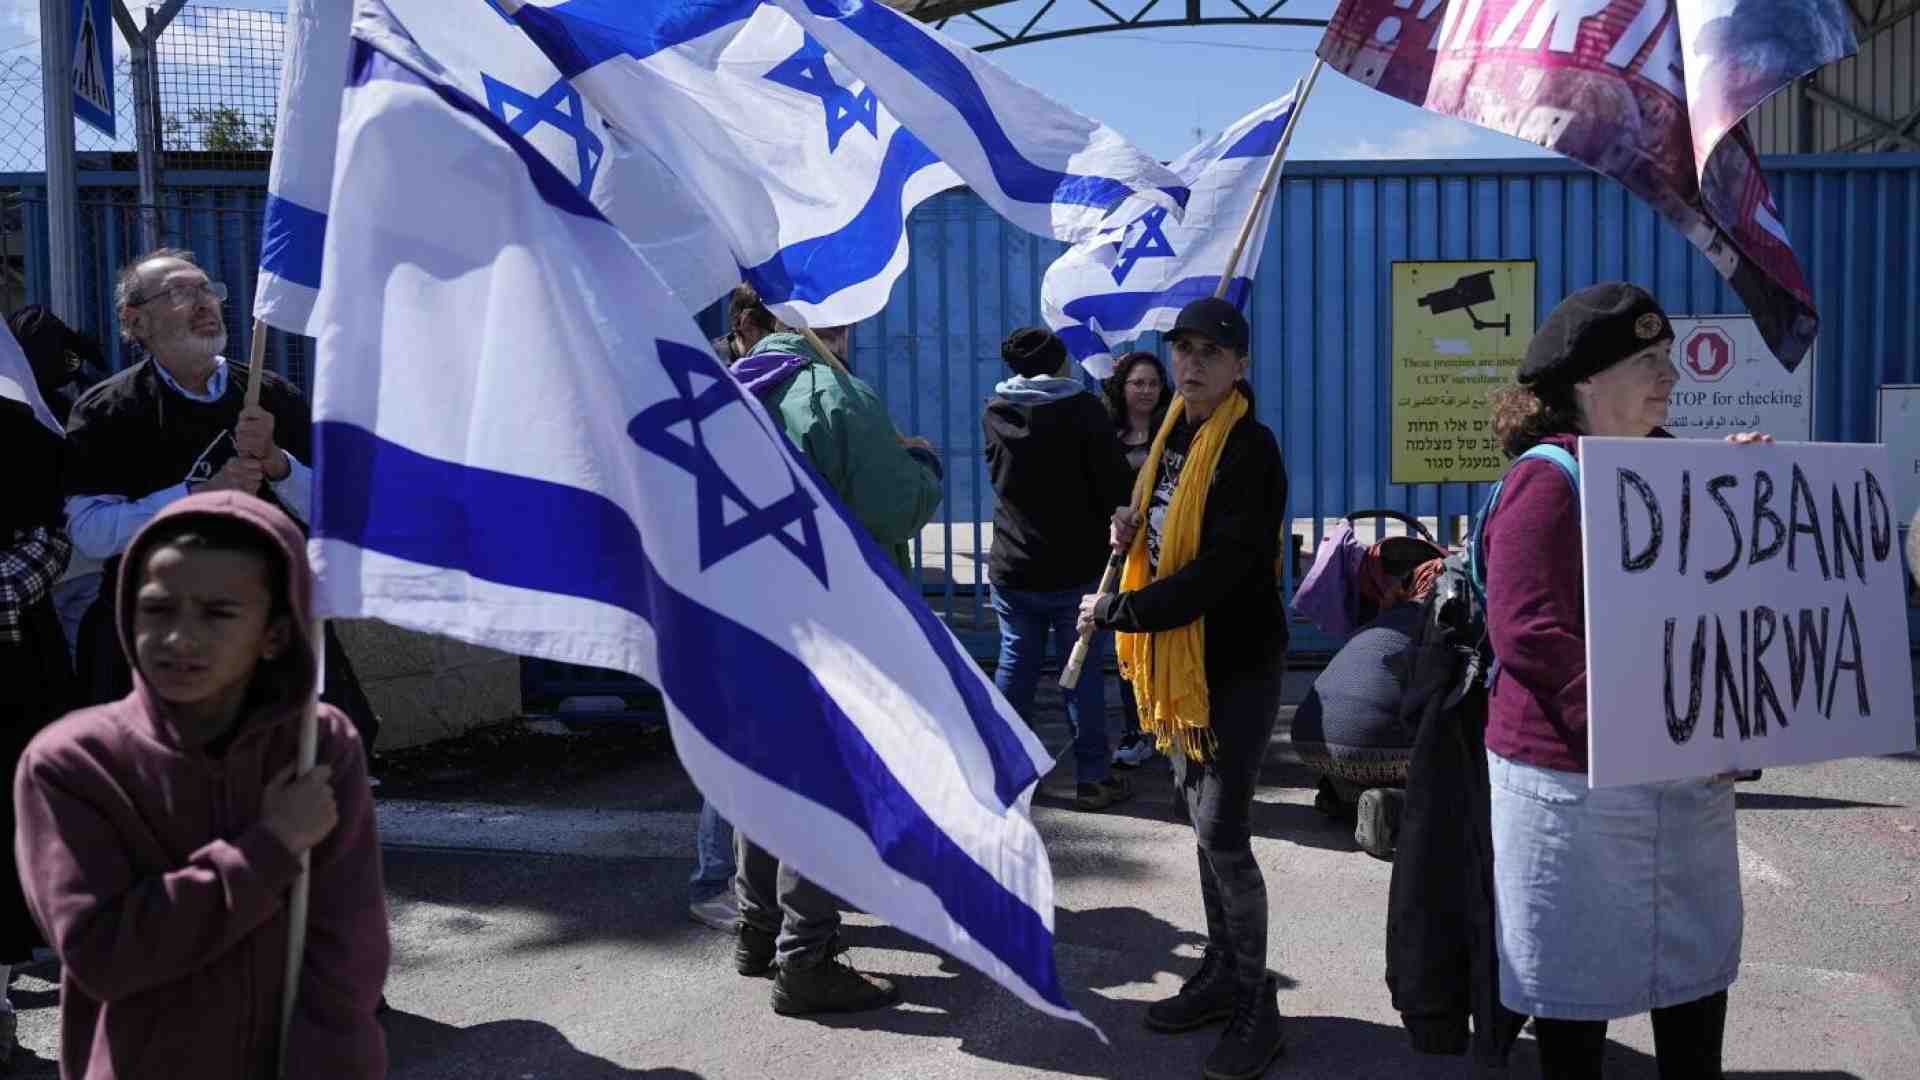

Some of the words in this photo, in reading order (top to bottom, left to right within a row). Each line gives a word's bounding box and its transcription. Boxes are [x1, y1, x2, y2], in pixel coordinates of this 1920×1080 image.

[1402, 358, 1432, 369] These
[1416, 375, 1449, 385] CCTV
[1712, 391, 1734, 406] for
[1738, 391, 1802, 408] checking
[1407, 420, 1439, 432] תחת
[1445, 418, 1467, 431] אלו
[1406, 437, 1452, 450] מצלמה
[1457, 436, 1477, 449] של
[1424, 457, 1454, 469] סגור
[1457, 454, 1501, 470] במעגל
[1617, 462, 1891, 585] DISBAND
[1664, 592, 1871, 745] UNRWA
